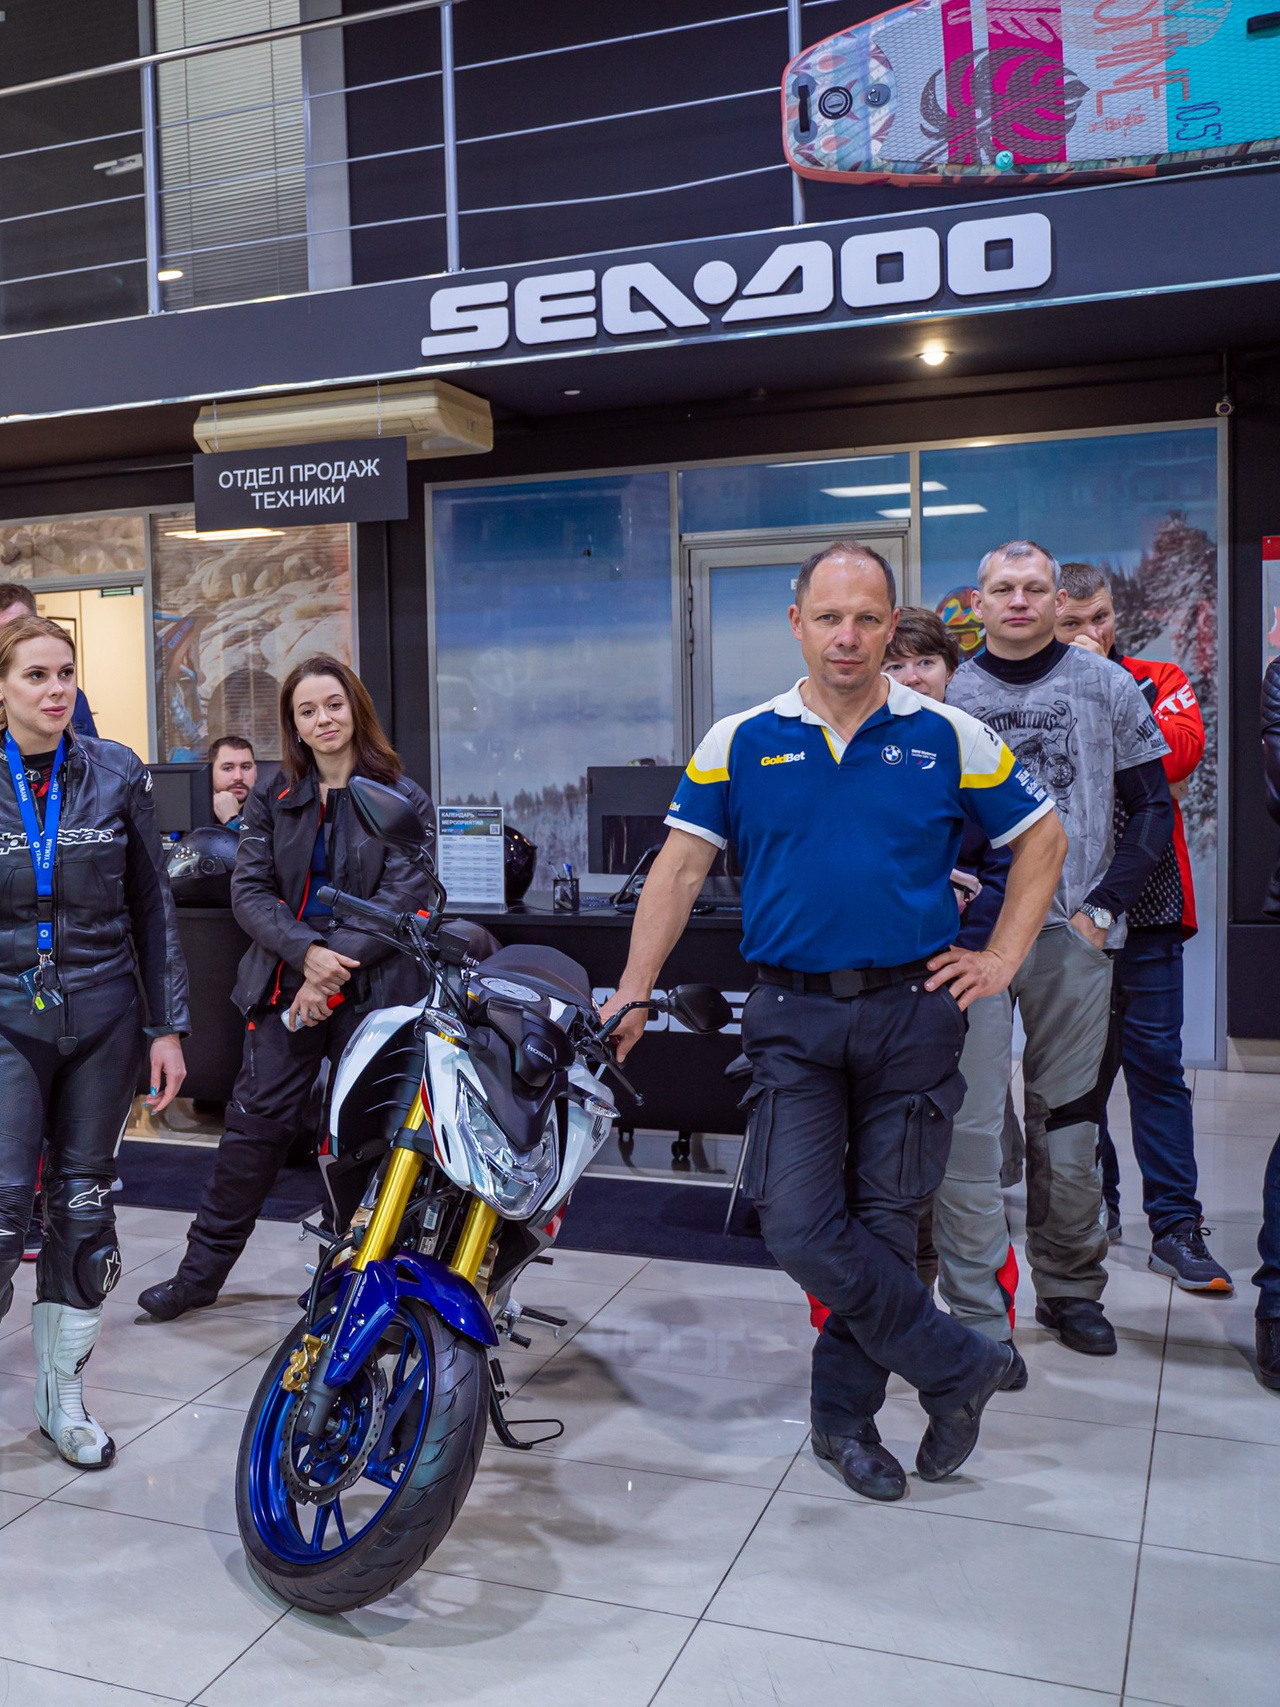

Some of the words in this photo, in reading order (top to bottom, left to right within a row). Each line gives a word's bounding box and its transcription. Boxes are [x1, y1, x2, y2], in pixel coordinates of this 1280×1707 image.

[218, 465, 284, 490] ОТДЕЛ
[290, 458, 380, 483] ПРОДАЖ
[251, 486, 345, 510] ТЕХНИКИ
[761, 750, 806, 767] GoldBet
[17, 780, 28, 802] YAMAHA
[44, 838, 53, 861] YAMAHA
[526, 1044, 553, 1064] HONDA
